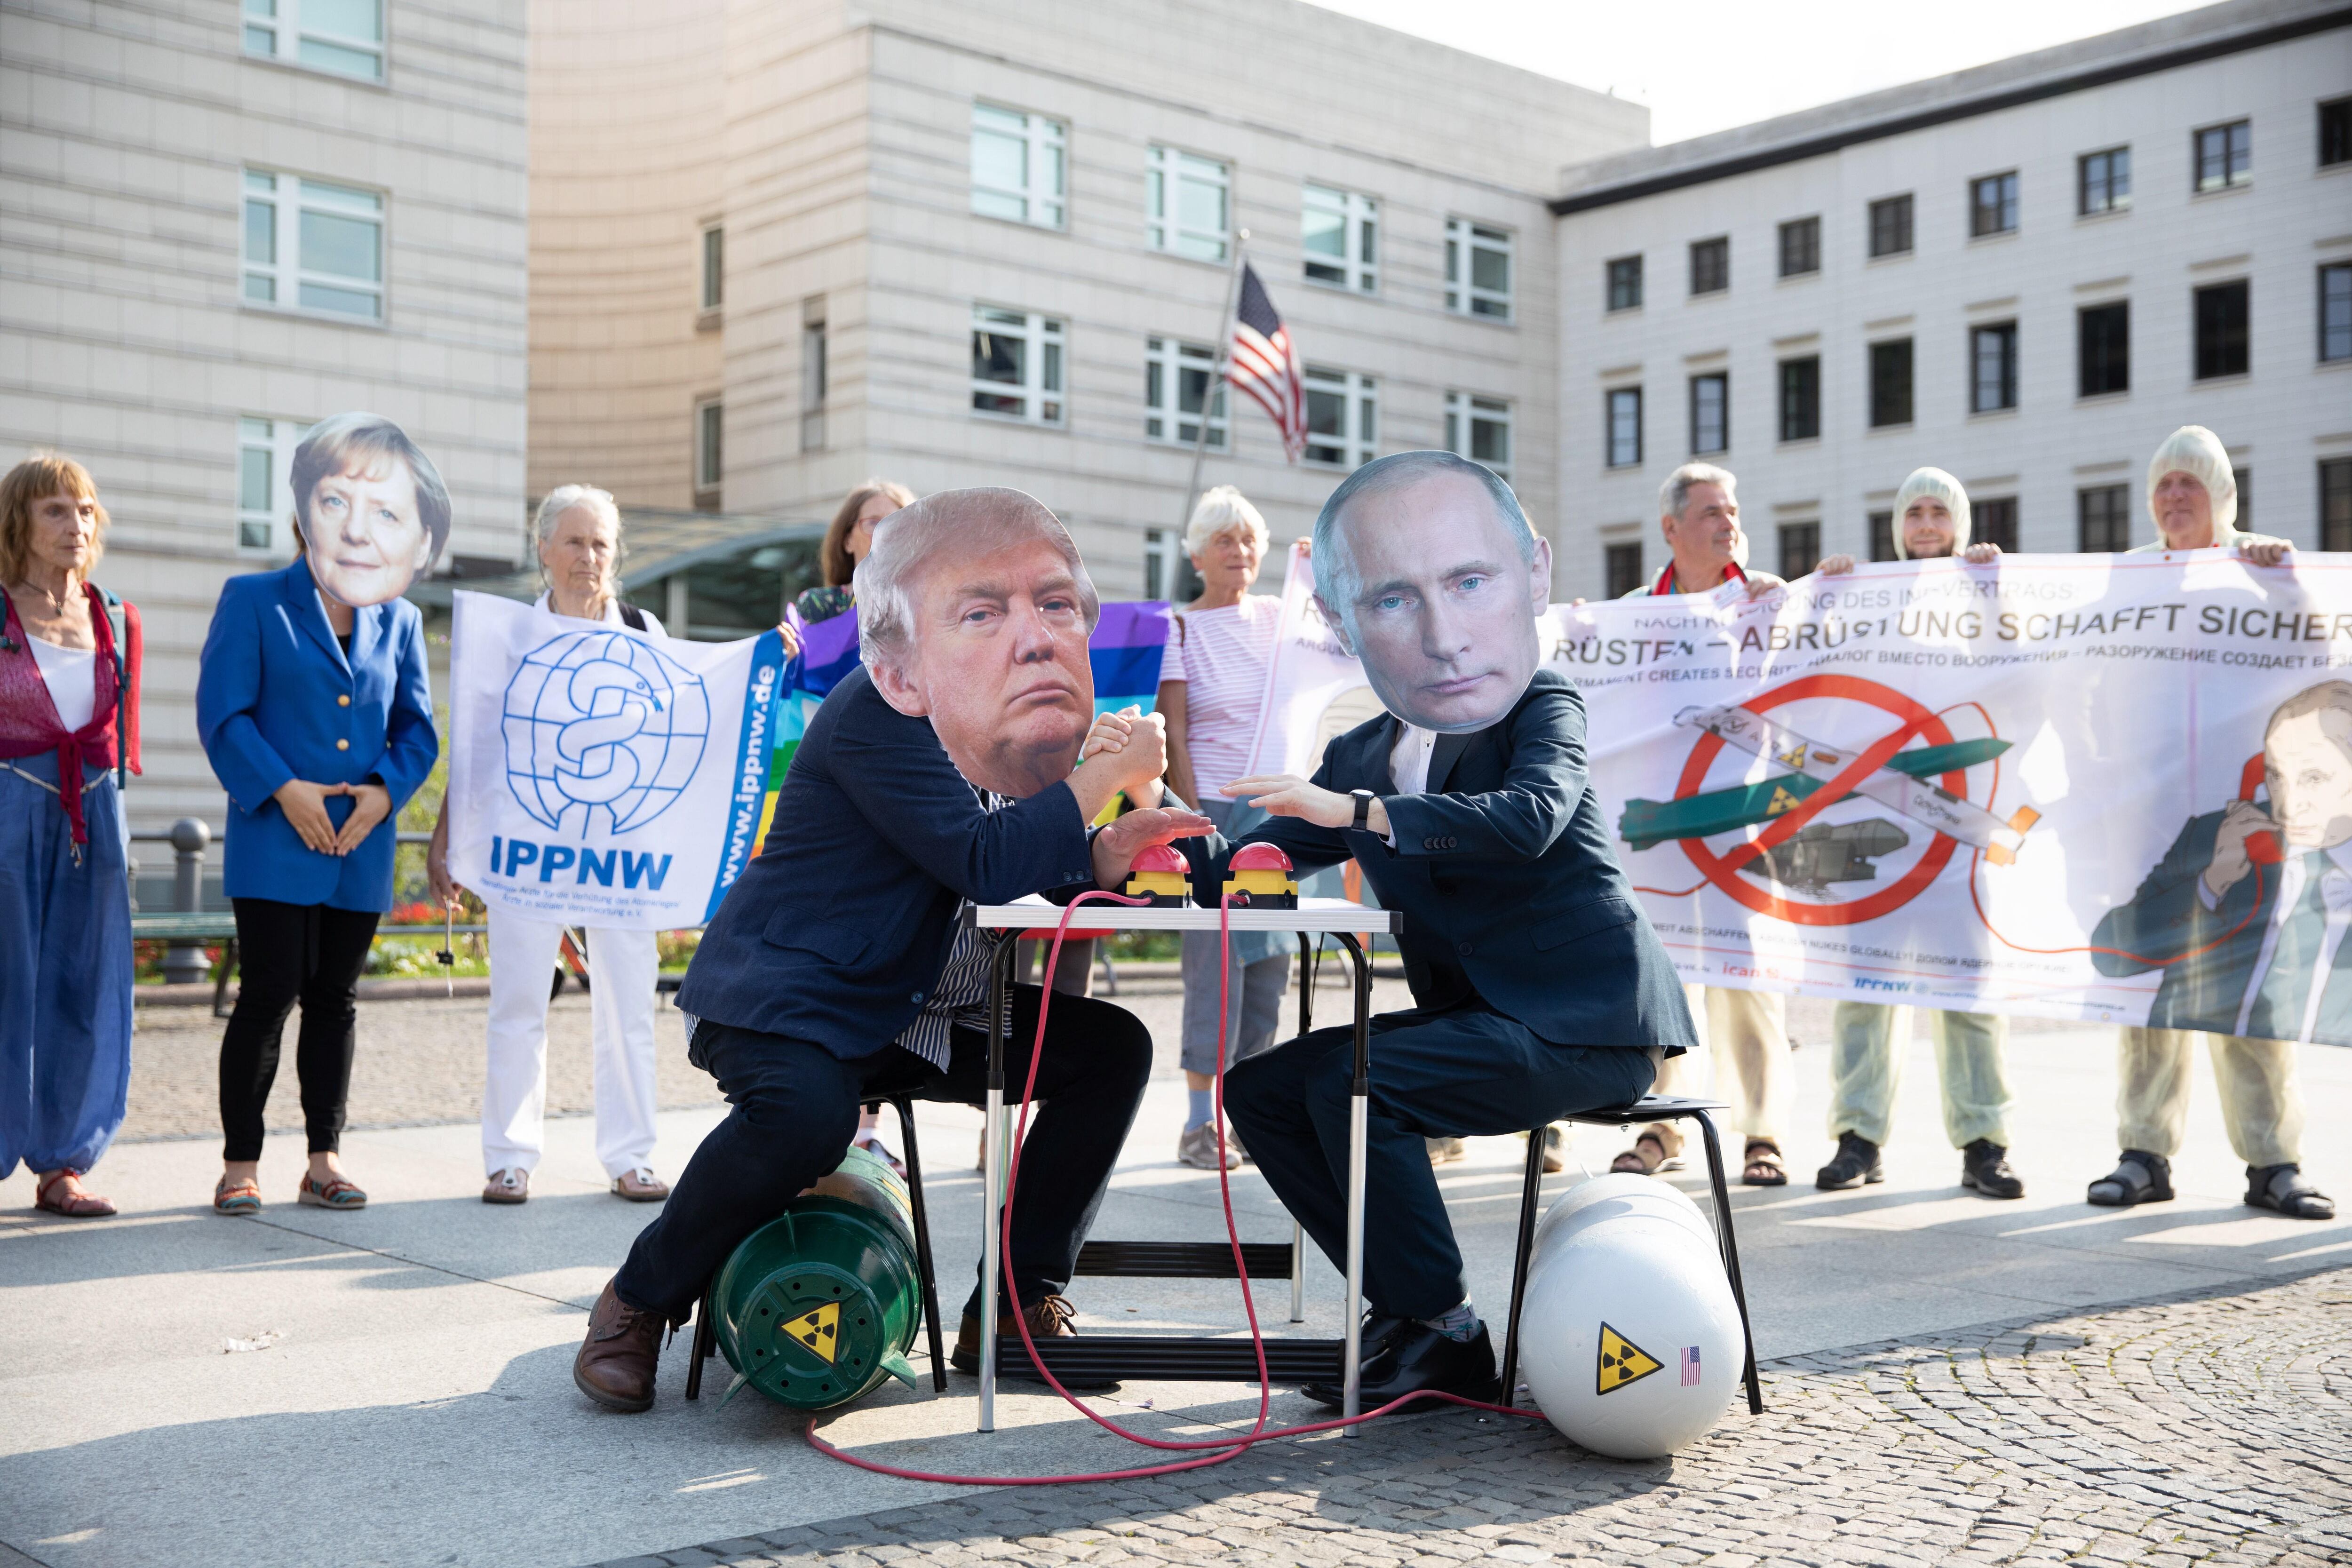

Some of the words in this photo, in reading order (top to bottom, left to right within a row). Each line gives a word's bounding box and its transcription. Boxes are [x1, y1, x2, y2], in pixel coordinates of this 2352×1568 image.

[1634, 616, 1698, 629] NACH
[1844, 589, 1891, 609] DES
[1553, 635, 1694, 665] RÜSTEN
[1997, 604, 2186, 641] SCHAFFT
[1877, 650, 1947, 666] ВМЕСТО
[2084, 644, 2217, 664] РАЗОРУЖЕНИЕ
[2222, 651, 2307, 670] СОЗДАЕТ
[2312, 653, 2352, 669] БЕЗ
[1649, 667, 1720, 683] CREATES
[721, 665, 776, 889] www.ippnw.de
[490, 835, 673, 891] IPPNW
[534, 901, 563, 909] sozialer
[1809, 939, 1848, 952] NUKES
[1722, 961, 1760, 979] ican
[1854, 976, 1912, 992] IPPNW
